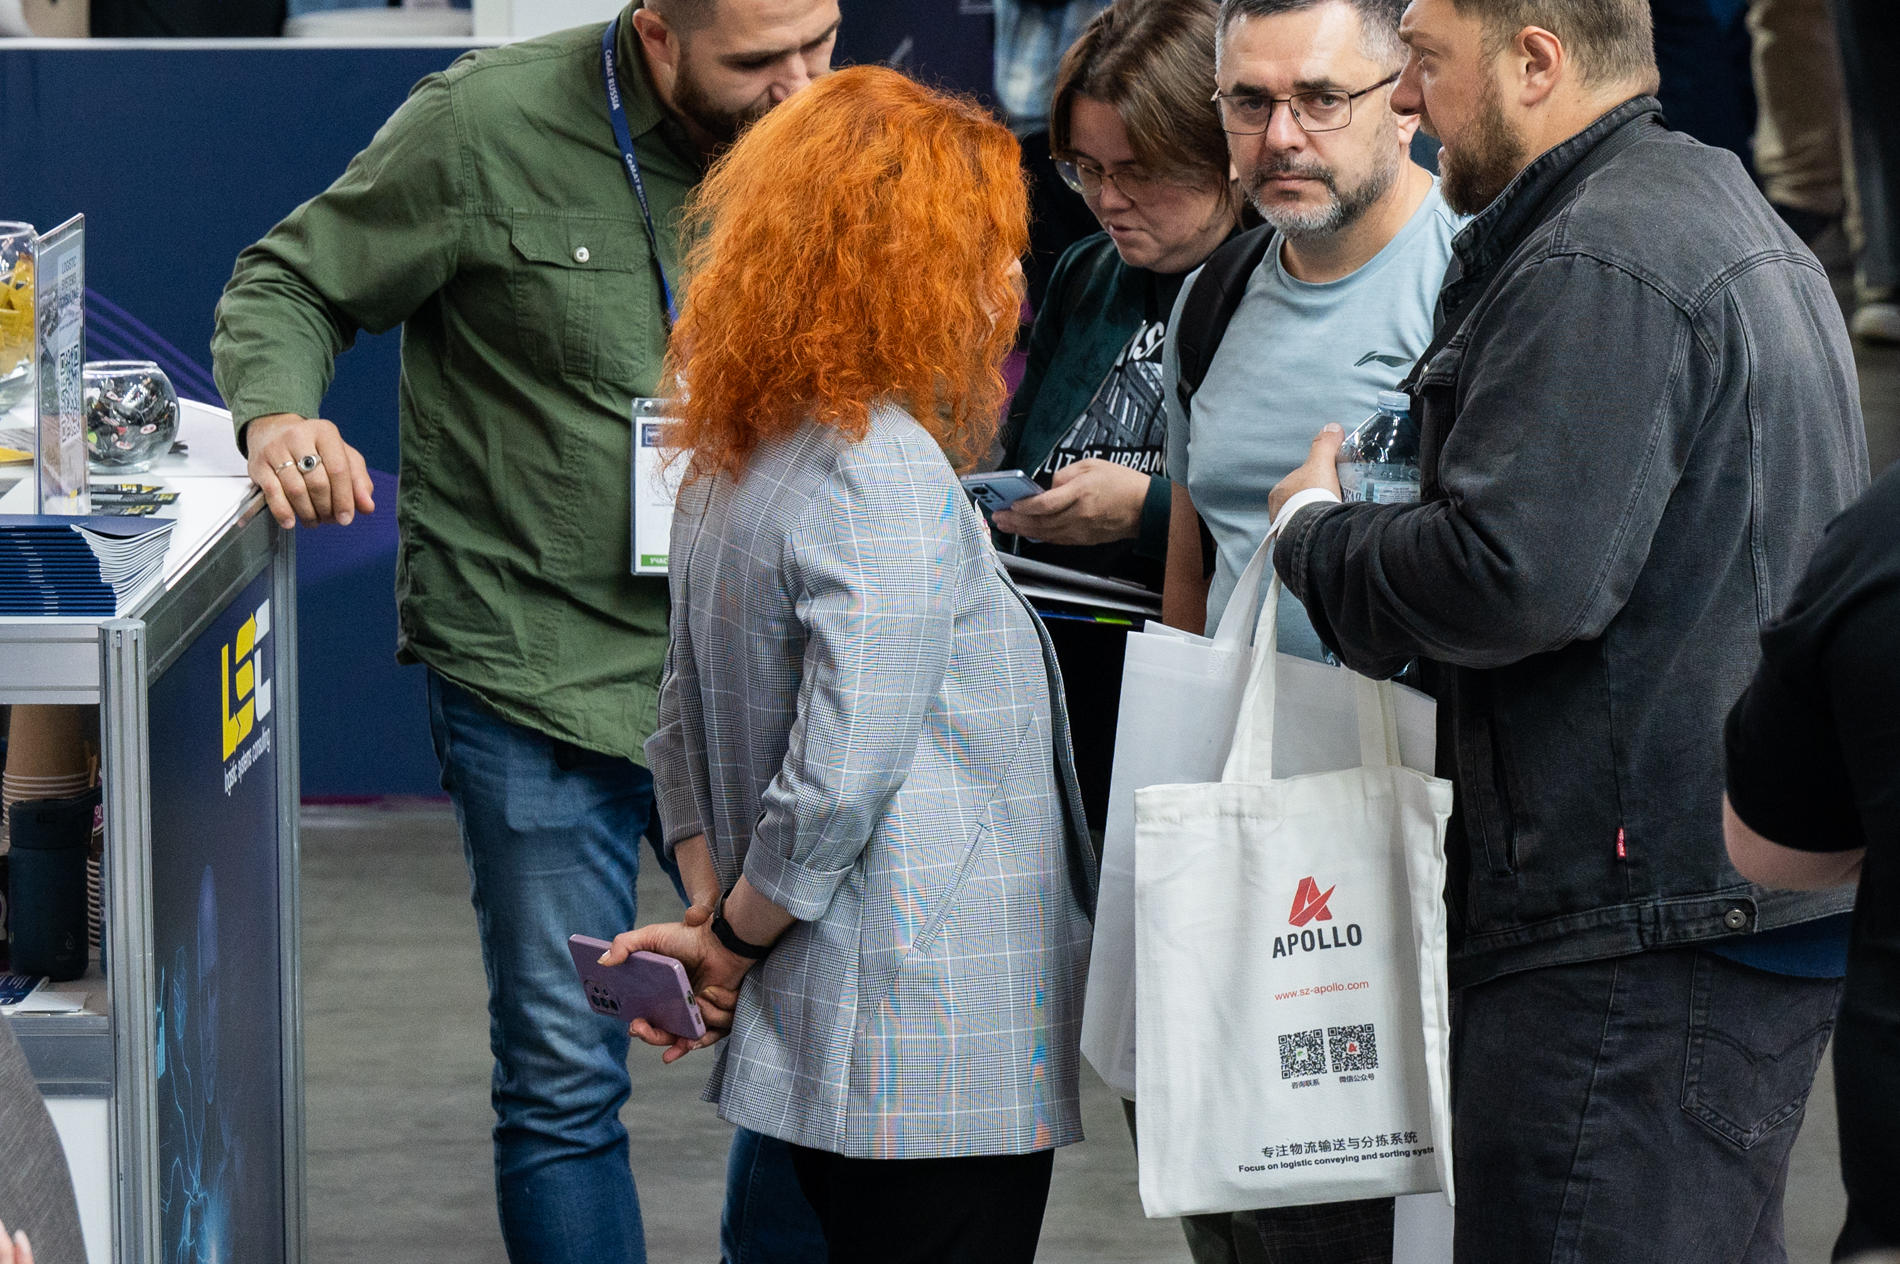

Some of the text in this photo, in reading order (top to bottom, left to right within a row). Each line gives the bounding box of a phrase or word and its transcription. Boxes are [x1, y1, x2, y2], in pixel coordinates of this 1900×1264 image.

[604, 49, 621, 111] CeMAT RUSSIA
[224, 725, 271, 797] logistic systems consulting
[1272, 923, 1363, 959] APOLLO
[1274, 980, 1370, 1002] www.sz-apollo.com
[1291, 1078, 1321, 1090] 咨询联系
[1338, 1072, 1376, 1084] 微信公众号
[1260, 1130, 1419, 1160] 专注物流输送与分拣系统
[1238, 1164, 1266, 1174] Focus
[1267, 1163, 1279, 1171] on
[1280, 1159, 1313, 1170] logistic
[1314, 1153, 1360, 1167] conveying
[1361, 1151, 1378, 1162] and
[1379, 1149, 1411, 1160] sorting
